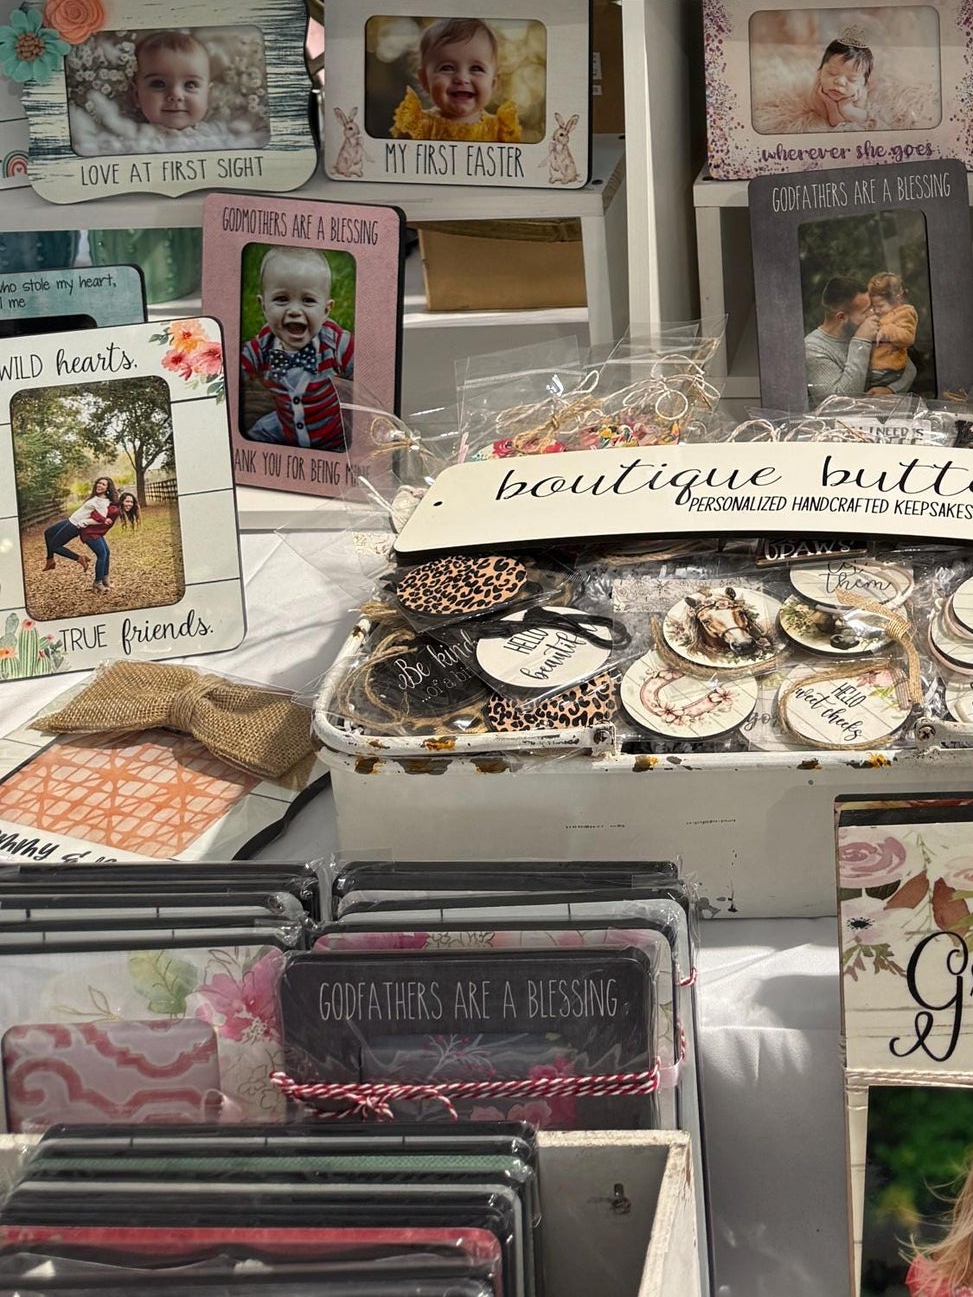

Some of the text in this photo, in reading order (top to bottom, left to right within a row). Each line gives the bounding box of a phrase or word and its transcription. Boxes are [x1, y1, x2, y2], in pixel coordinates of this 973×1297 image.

[384, 142, 525, 178] MY FIRST EASTER
[761, 140, 935, 163] wherever she goes
[80, 155, 264, 187] LOVE AT FIRST SIGHT
[772, 172, 951, 213] GODFATHERS ARE A BLESSING
[222, 206, 379, 246] GODMOTHERS ARE A BLESSING
[22, 273, 117, 295] stole my heart,
[56, 342, 138, 376] hearts.
[262, 453, 340, 485] YOU FOR BEING
[495, 458, 782, 506] boutique
[689, 496, 787, 511] PERSONALIZED
[791, 497, 889, 514] HANDCRAFTED
[894, 500, 973, 520] KEEPSAKES
[59, 610, 215, 655] TRUE friends.
[398, 658, 431, 690] Be
[831, 682, 867, 708] HELLO
[820, 708, 863, 741] cheeks
[319, 979, 618, 1021] GODFATHERS ARE A BLESSING
